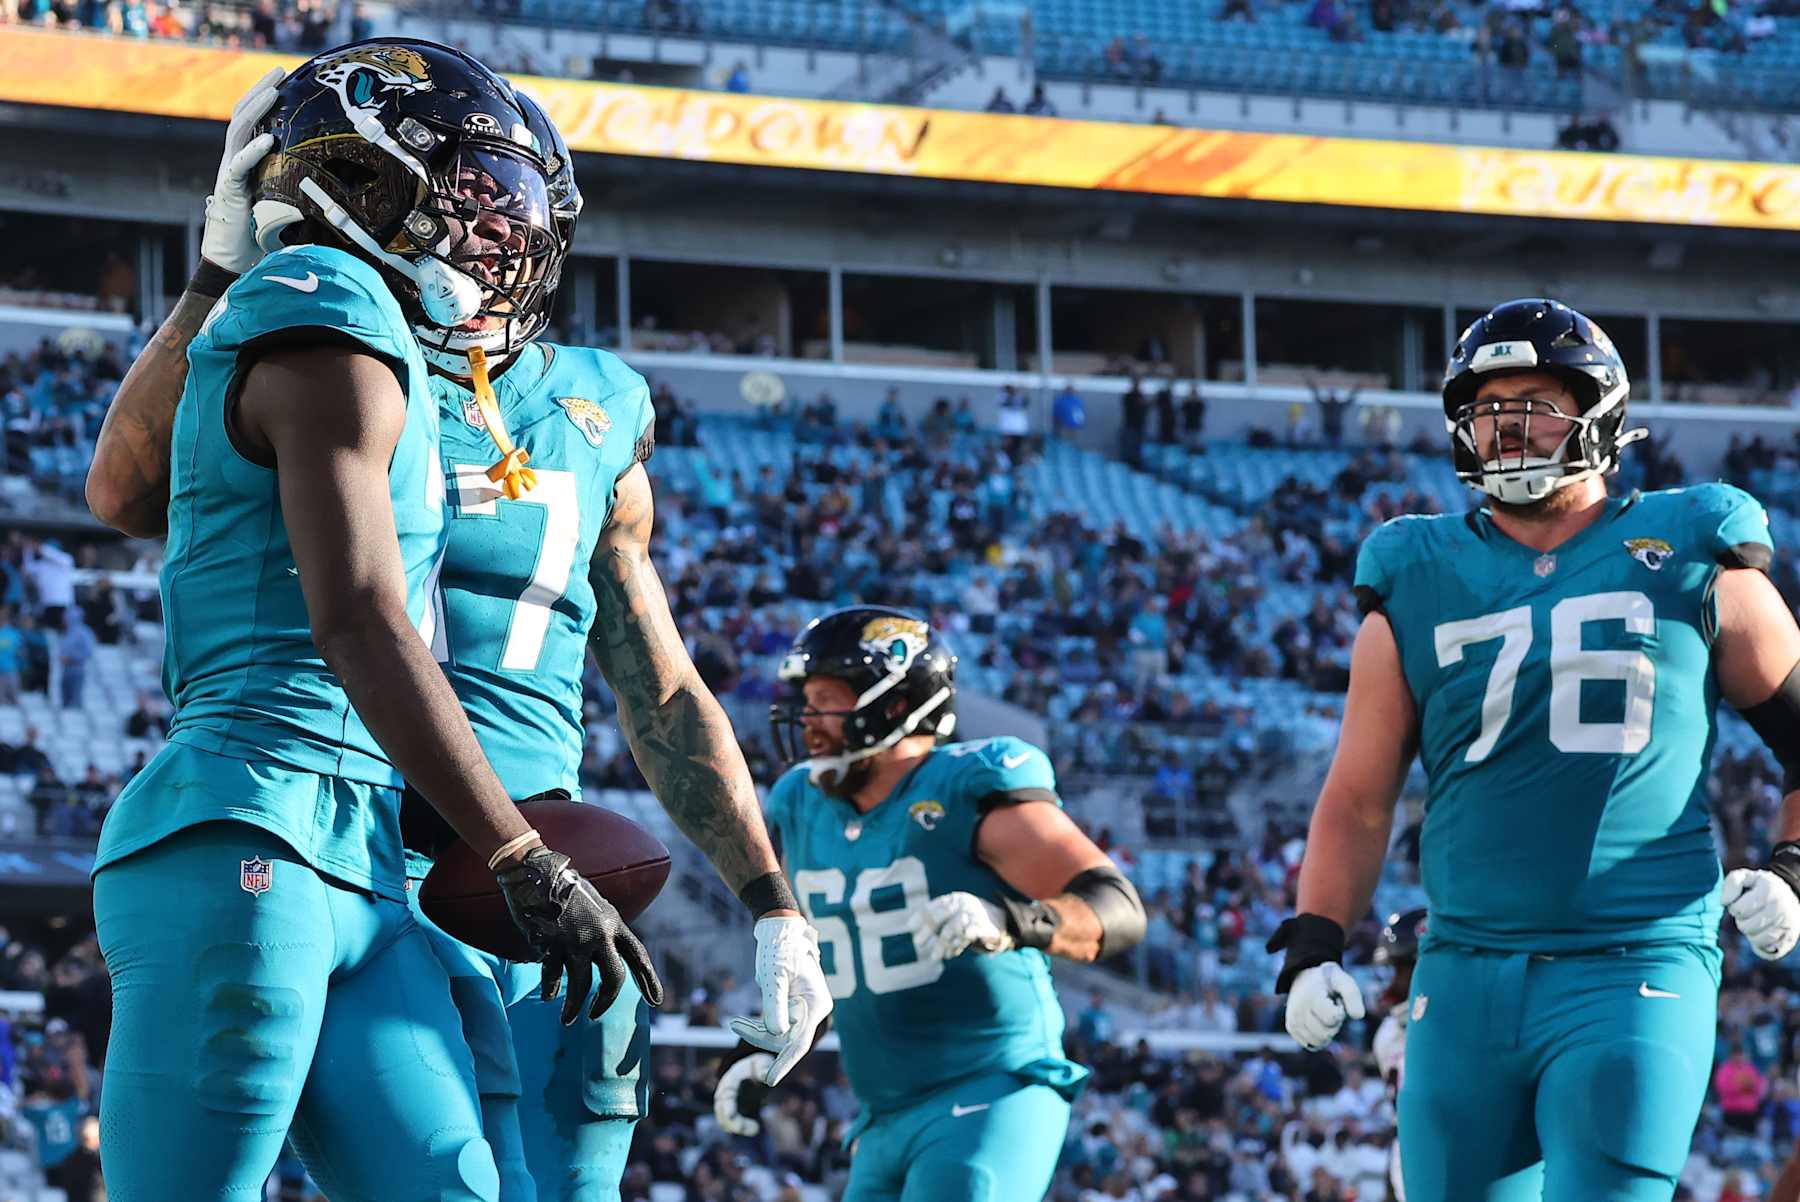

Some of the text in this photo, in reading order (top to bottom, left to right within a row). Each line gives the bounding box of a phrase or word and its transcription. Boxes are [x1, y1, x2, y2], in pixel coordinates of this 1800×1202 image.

[464, 123, 501, 135] OAKLEY
[433, 463, 580, 671] 7
[1434, 590, 1656, 763] 76
[245, 873, 269, 889] NFL
[795, 855, 944, 1000] 68
